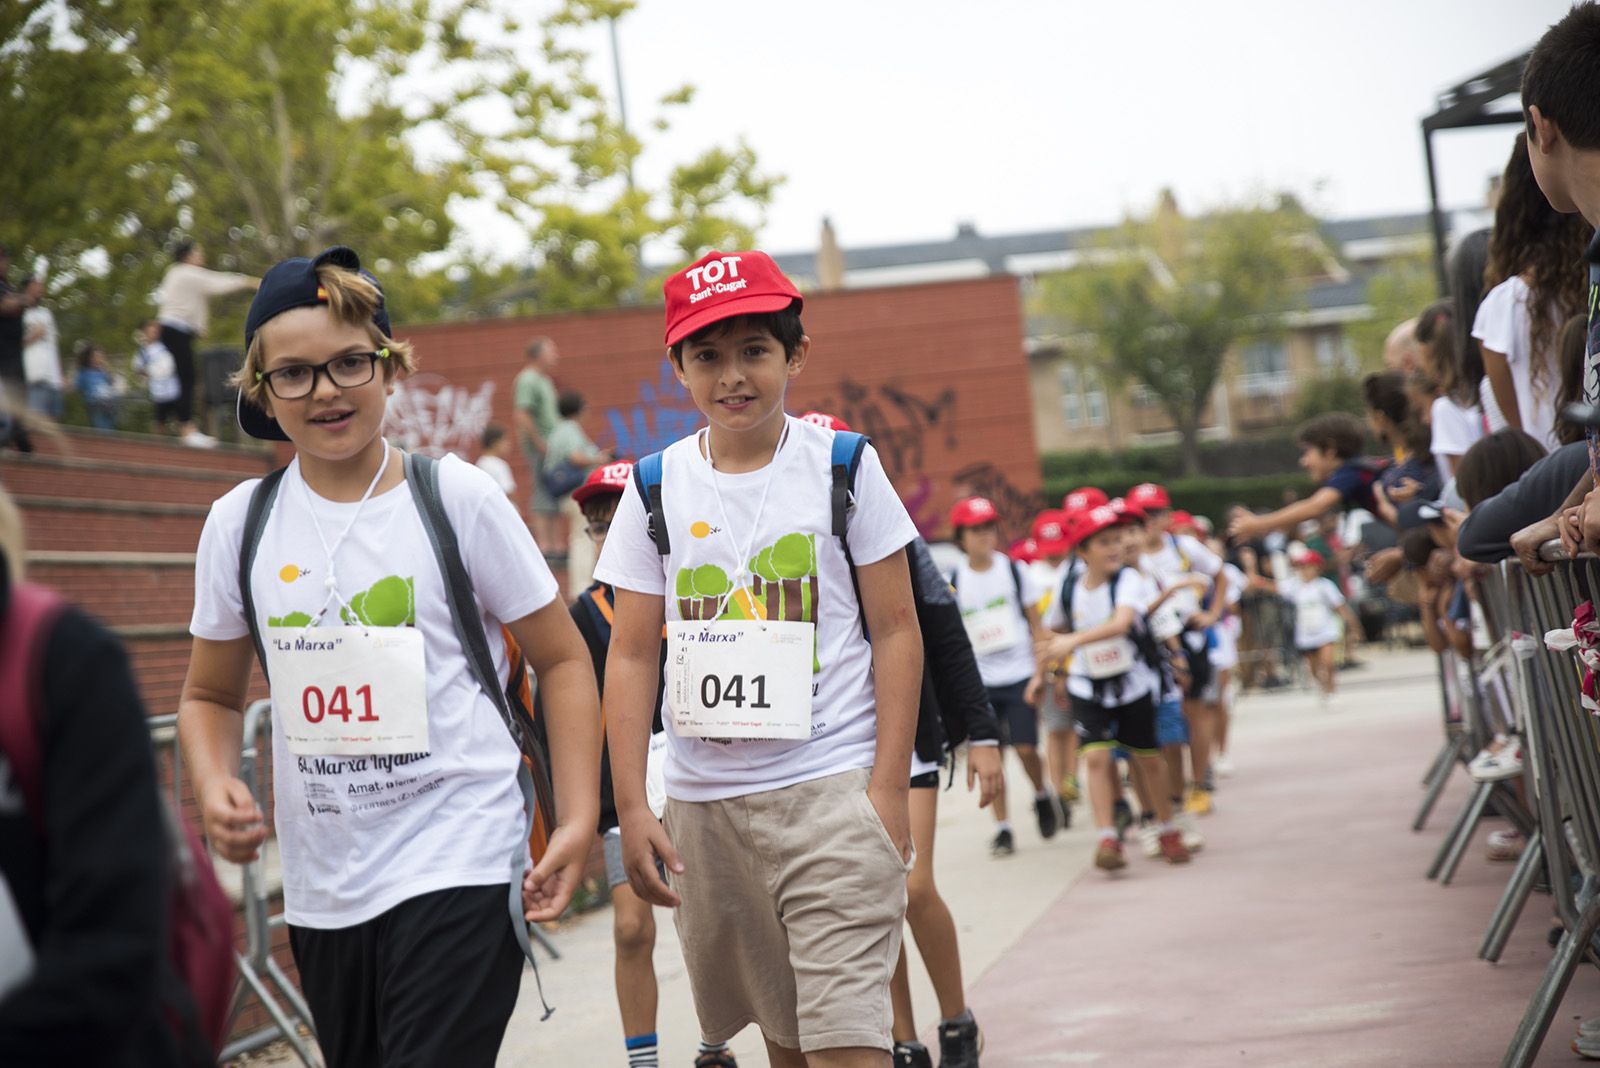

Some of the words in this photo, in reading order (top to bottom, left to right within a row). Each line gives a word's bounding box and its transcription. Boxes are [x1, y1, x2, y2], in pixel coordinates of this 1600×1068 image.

[686, 256, 742, 291] TOT
[689, 287, 713, 304] Sant
[715, 278, 748, 295] Cugat
[272, 639, 291, 651] “La
[295, 637, 342, 651] Marxa”
[698, 631, 744, 643] Marxa”
[302, 684, 379, 724] 041
[701, 674, 771, 709] 041
[314, 757, 367, 776] Marxa
